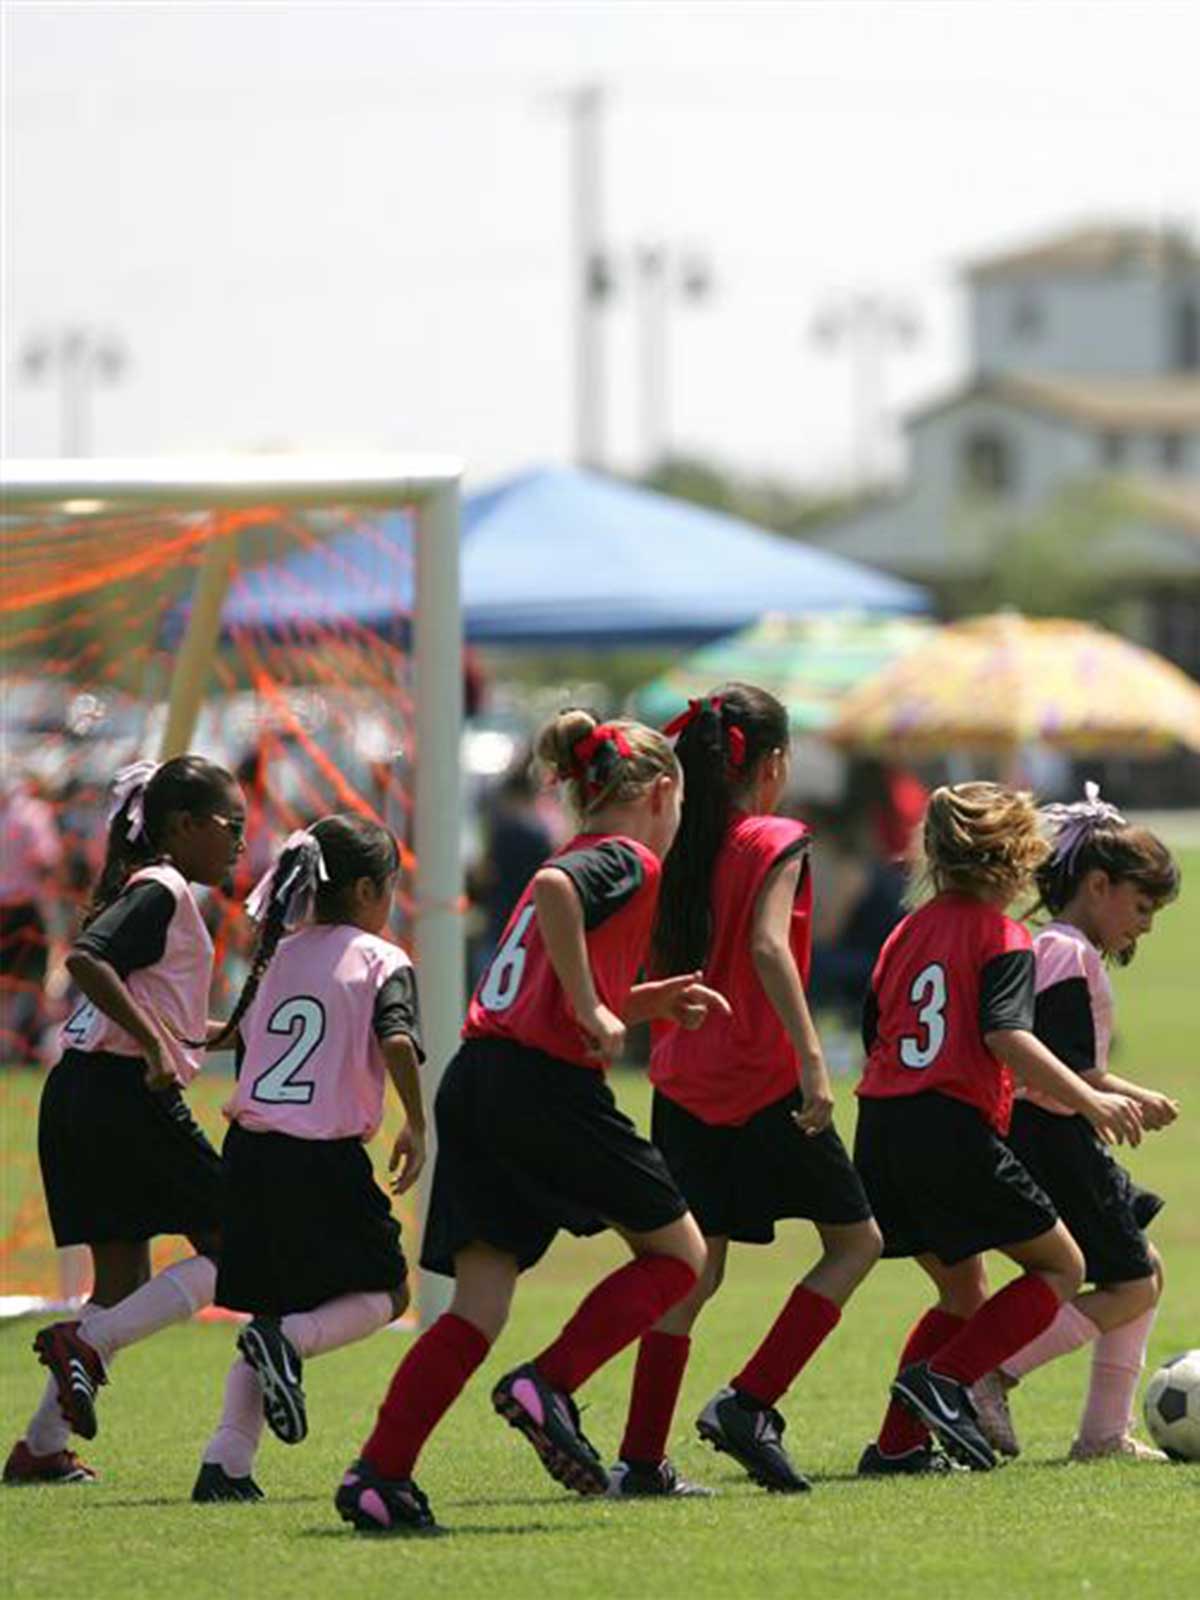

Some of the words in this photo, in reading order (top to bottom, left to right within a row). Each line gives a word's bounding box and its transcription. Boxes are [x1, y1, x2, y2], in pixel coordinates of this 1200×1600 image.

[479, 901, 536, 1011] 6
[251, 994, 327, 1105] 2
[898, 962, 947, 1070] 3
